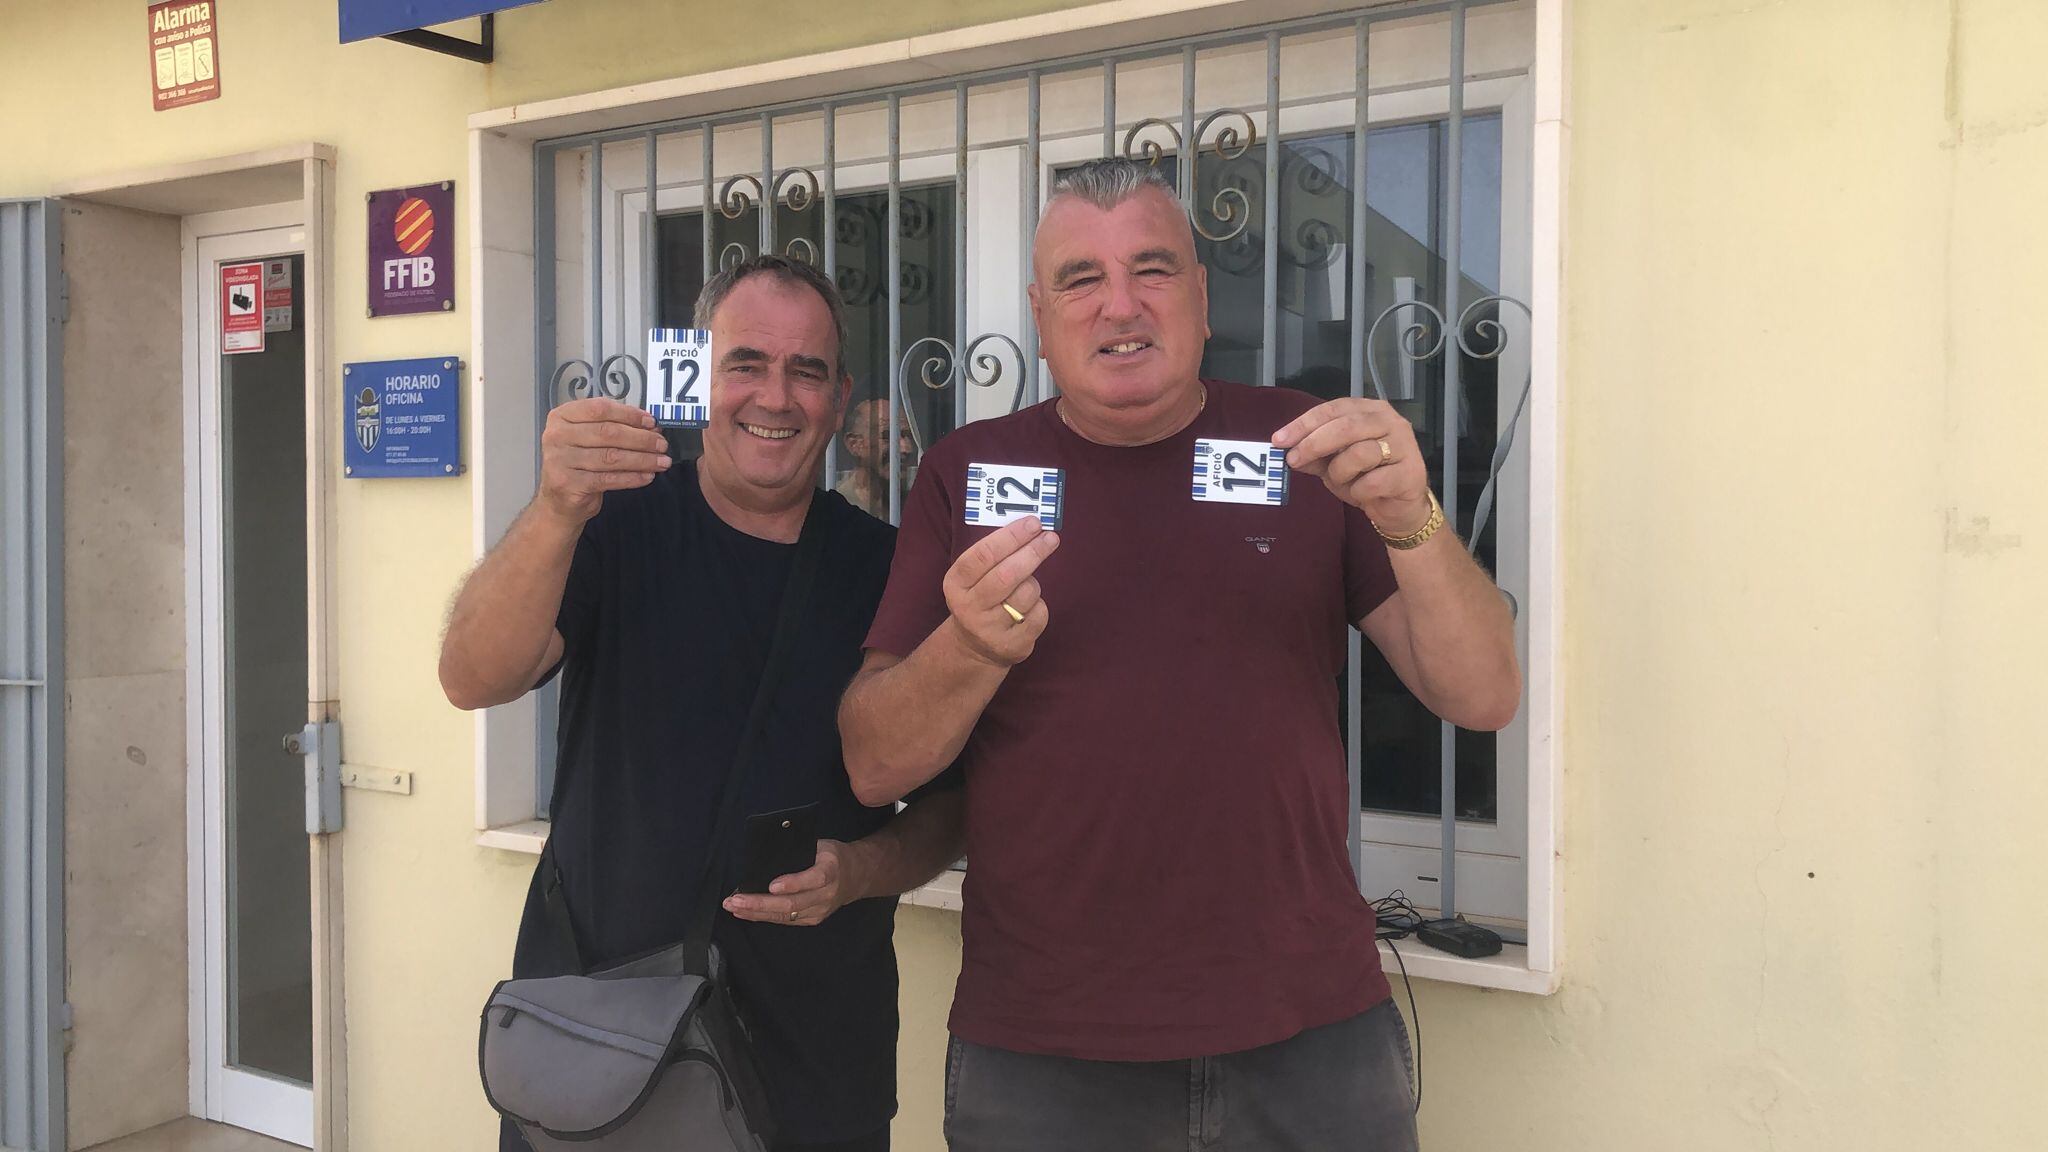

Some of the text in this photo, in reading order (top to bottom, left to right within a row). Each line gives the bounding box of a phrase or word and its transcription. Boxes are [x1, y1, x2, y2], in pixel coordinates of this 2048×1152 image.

[154, 2, 210, 33] Alarma
[154, 36, 167, 46] con
[167, 31, 184, 43] aviso
[190, 22, 211, 37] Policía
[235, 268, 248, 276] ZONA
[384, 256, 435, 290] FFIB
[663, 347, 698, 357] AFICIÓ
[385, 374, 440, 391] HORARIO
[658, 358, 700, 403] 12
[385, 392, 424, 405] OFICINA
[385, 414, 446, 424] DE LUNES A VIERNES
[1211, 453, 1222, 487] AFICIÓ
[1222, 451, 1267, 492] 12
[986, 477, 995, 512] AFICIÓ
[995, 476, 1041, 516] 12
